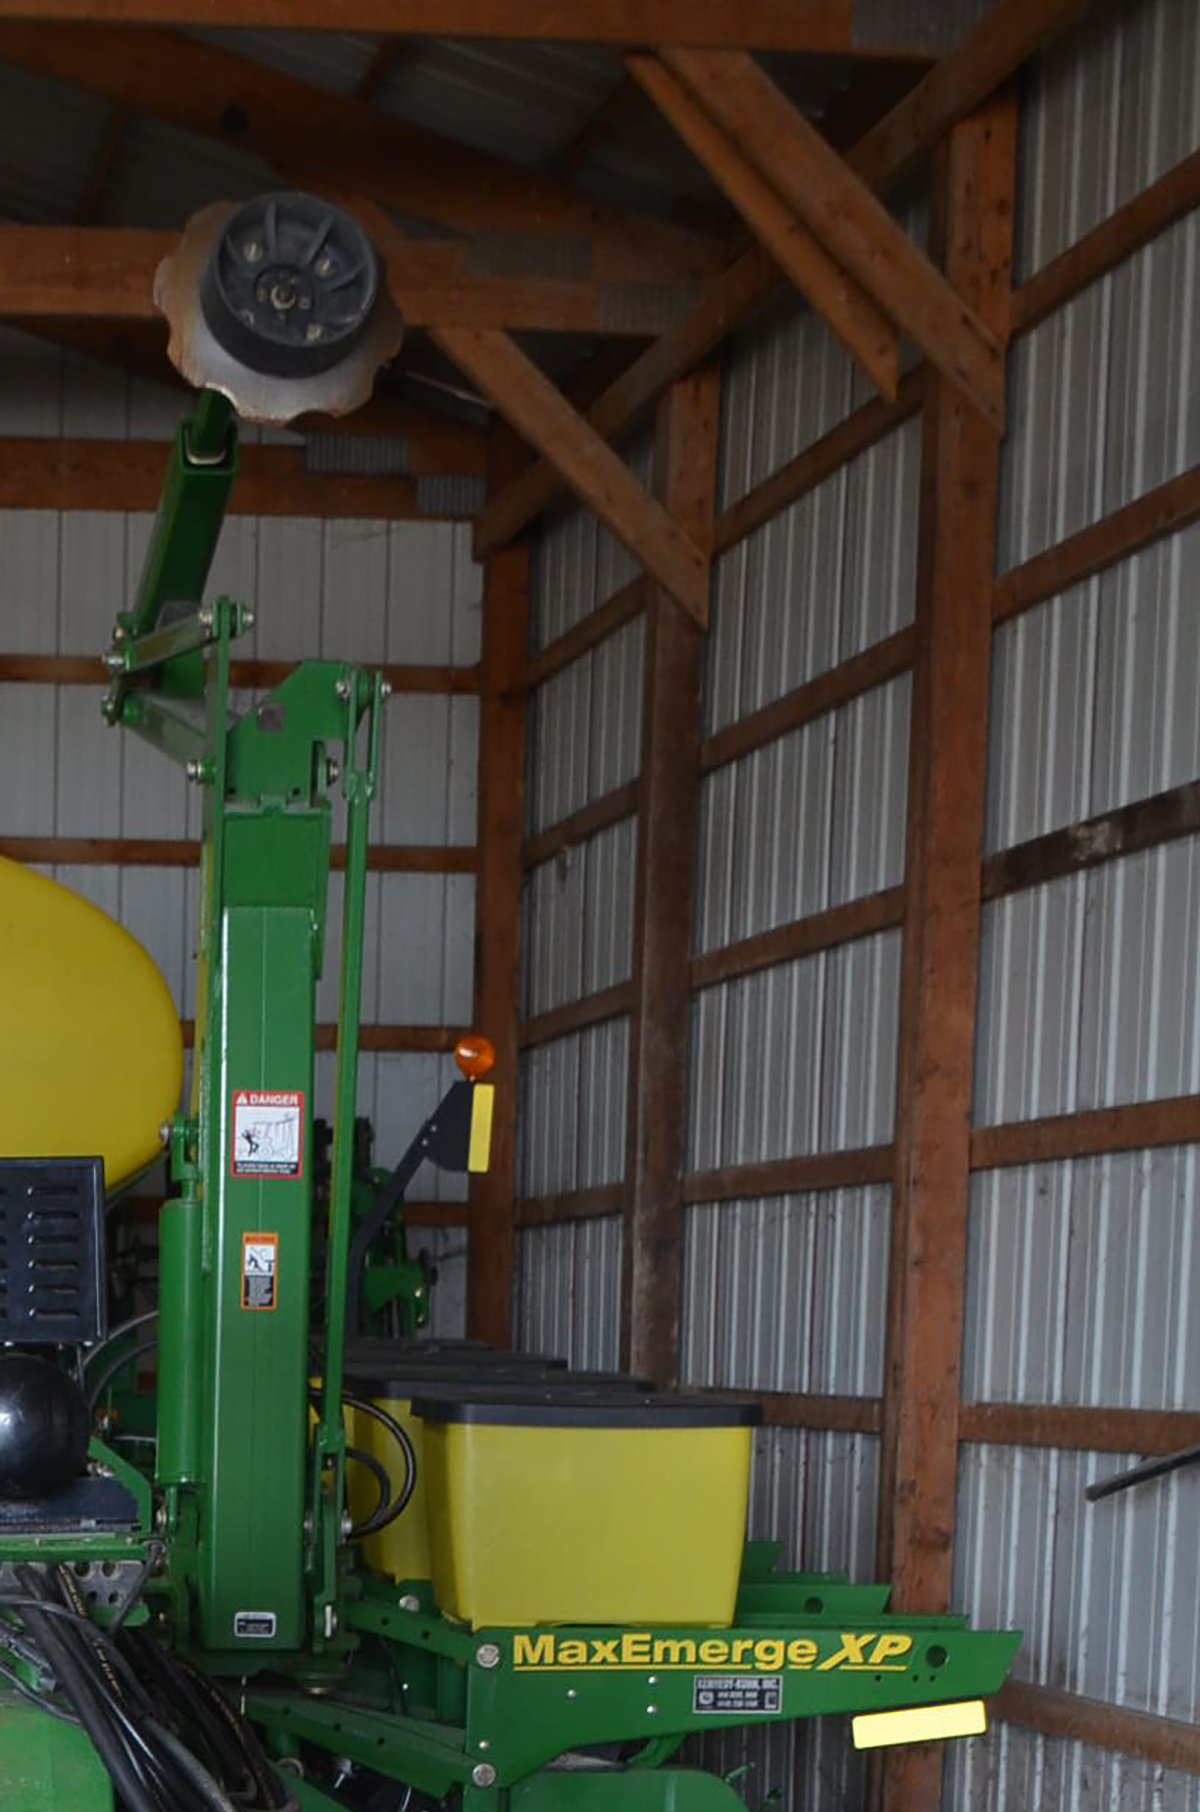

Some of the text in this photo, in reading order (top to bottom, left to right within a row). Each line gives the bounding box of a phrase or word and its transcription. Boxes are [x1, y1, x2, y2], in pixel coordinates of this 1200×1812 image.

[249, 1093, 298, 1105] DANGER
[513, 1633, 912, 1670] MaxEmerge XP
